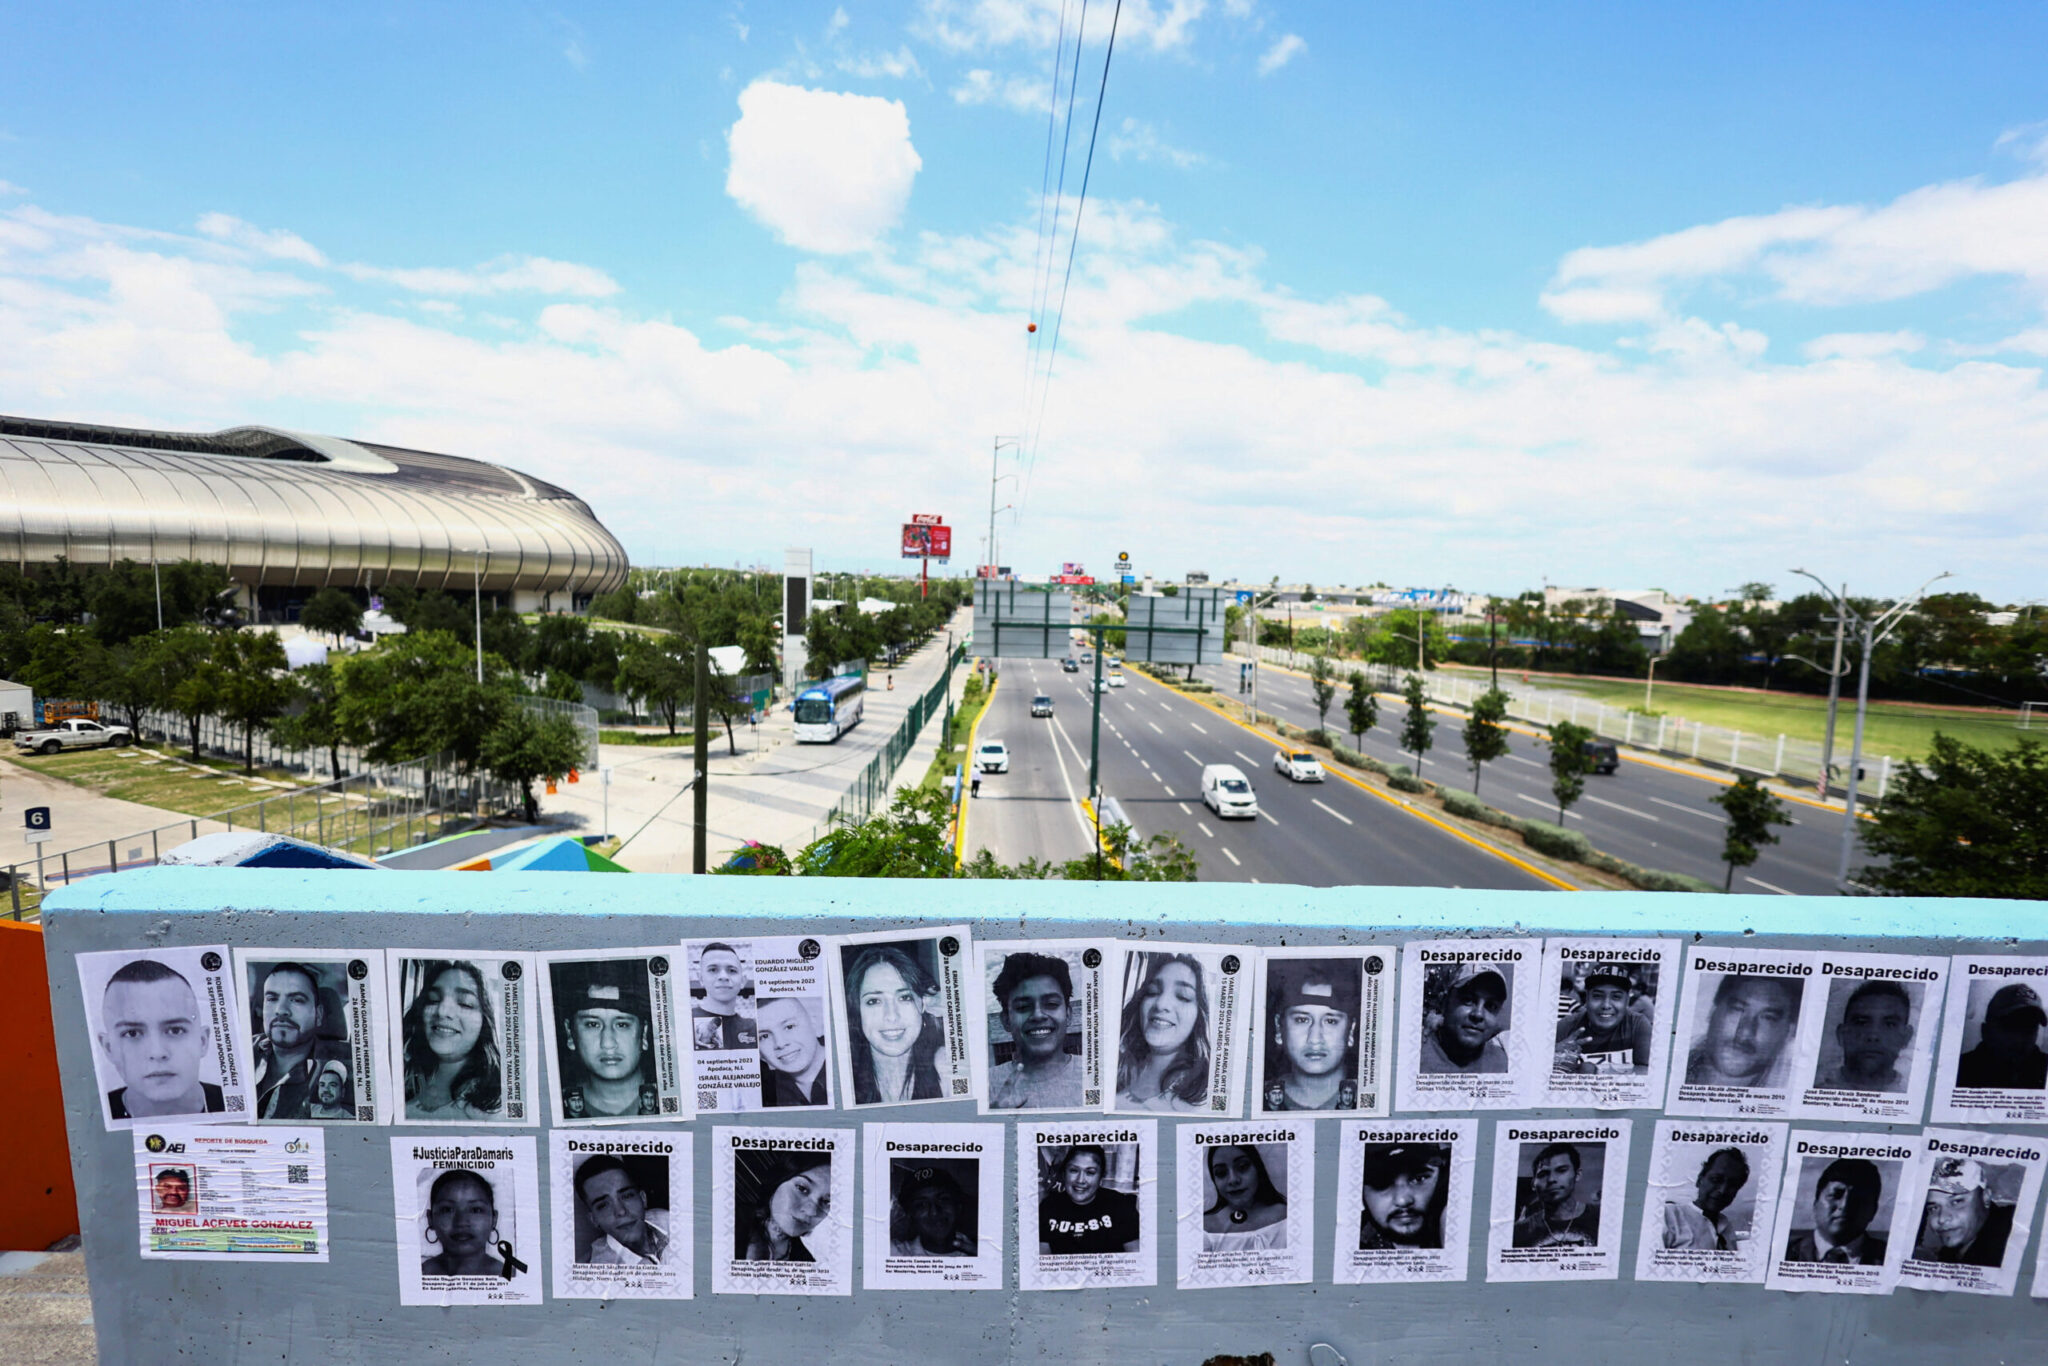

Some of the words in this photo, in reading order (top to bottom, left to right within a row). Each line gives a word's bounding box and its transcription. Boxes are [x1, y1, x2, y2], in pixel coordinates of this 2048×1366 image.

[31, 812, 43, 825] 6
[1420, 948, 1522, 964] Desaparecido
[1561, 948, 1662, 962] Desaparecido
[1694, 958, 1813, 976] Desaparecido
[1822, 962, 1939, 980] Desaparecido
[205, 976, 212, 985] 04
[214, 976, 225, 1005] ROBERTO
[359, 983, 367, 1008] RAMÓN
[1226, 976, 1234, 1008] YAMILETH
[207, 986, 218, 1025] SEPTIEMBRE
[352, 997, 357, 1005] 26
[219, 1007, 229, 1031] CARLOS
[946, 1001, 954, 1035] CADEREYTA
[213, 1026, 221, 1041] 2023
[1223, 1009, 1231, 1046] GUADALUPE
[223, 1032, 232, 1051] MOTA
[215, 1042, 227, 1075] APODACA,
[227, 1052, 239, 1086] GONZÁLEZ
[1213, 1053, 1221, 1093] TAMAULIPAS
[698, 1081, 732, 1089] GONZÁLEZ
[1036, 1130, 1138, 1147] Desaparecida
[1195, 1128, 1296, 1146] Desaparecida
[1358, 1128, 1458, 1145] Desaparecido
[1508, 1128, 1620, 1142] Desaparecido
[1672, 1130, 1768, 1147] Desaparecido
[166, 1143, 185, 1153] AEI
[568, 1140, 673, 1156] Desaparecido
[731, 1136, 835, 1152] Desaparecida
[886, 1142, 983, 1154] Desaparecido
[1796, 1142, 1912, 1160] Desaparecido
[1928, 1139, 2040, 1162] Desaparecido
[413, 1147, 513, 1160] #JusticiaParaDamaris
[433, 1161, 494, 1169] FEMINICIDIO
[156, 1219, 199, 1227] MIGUEL
